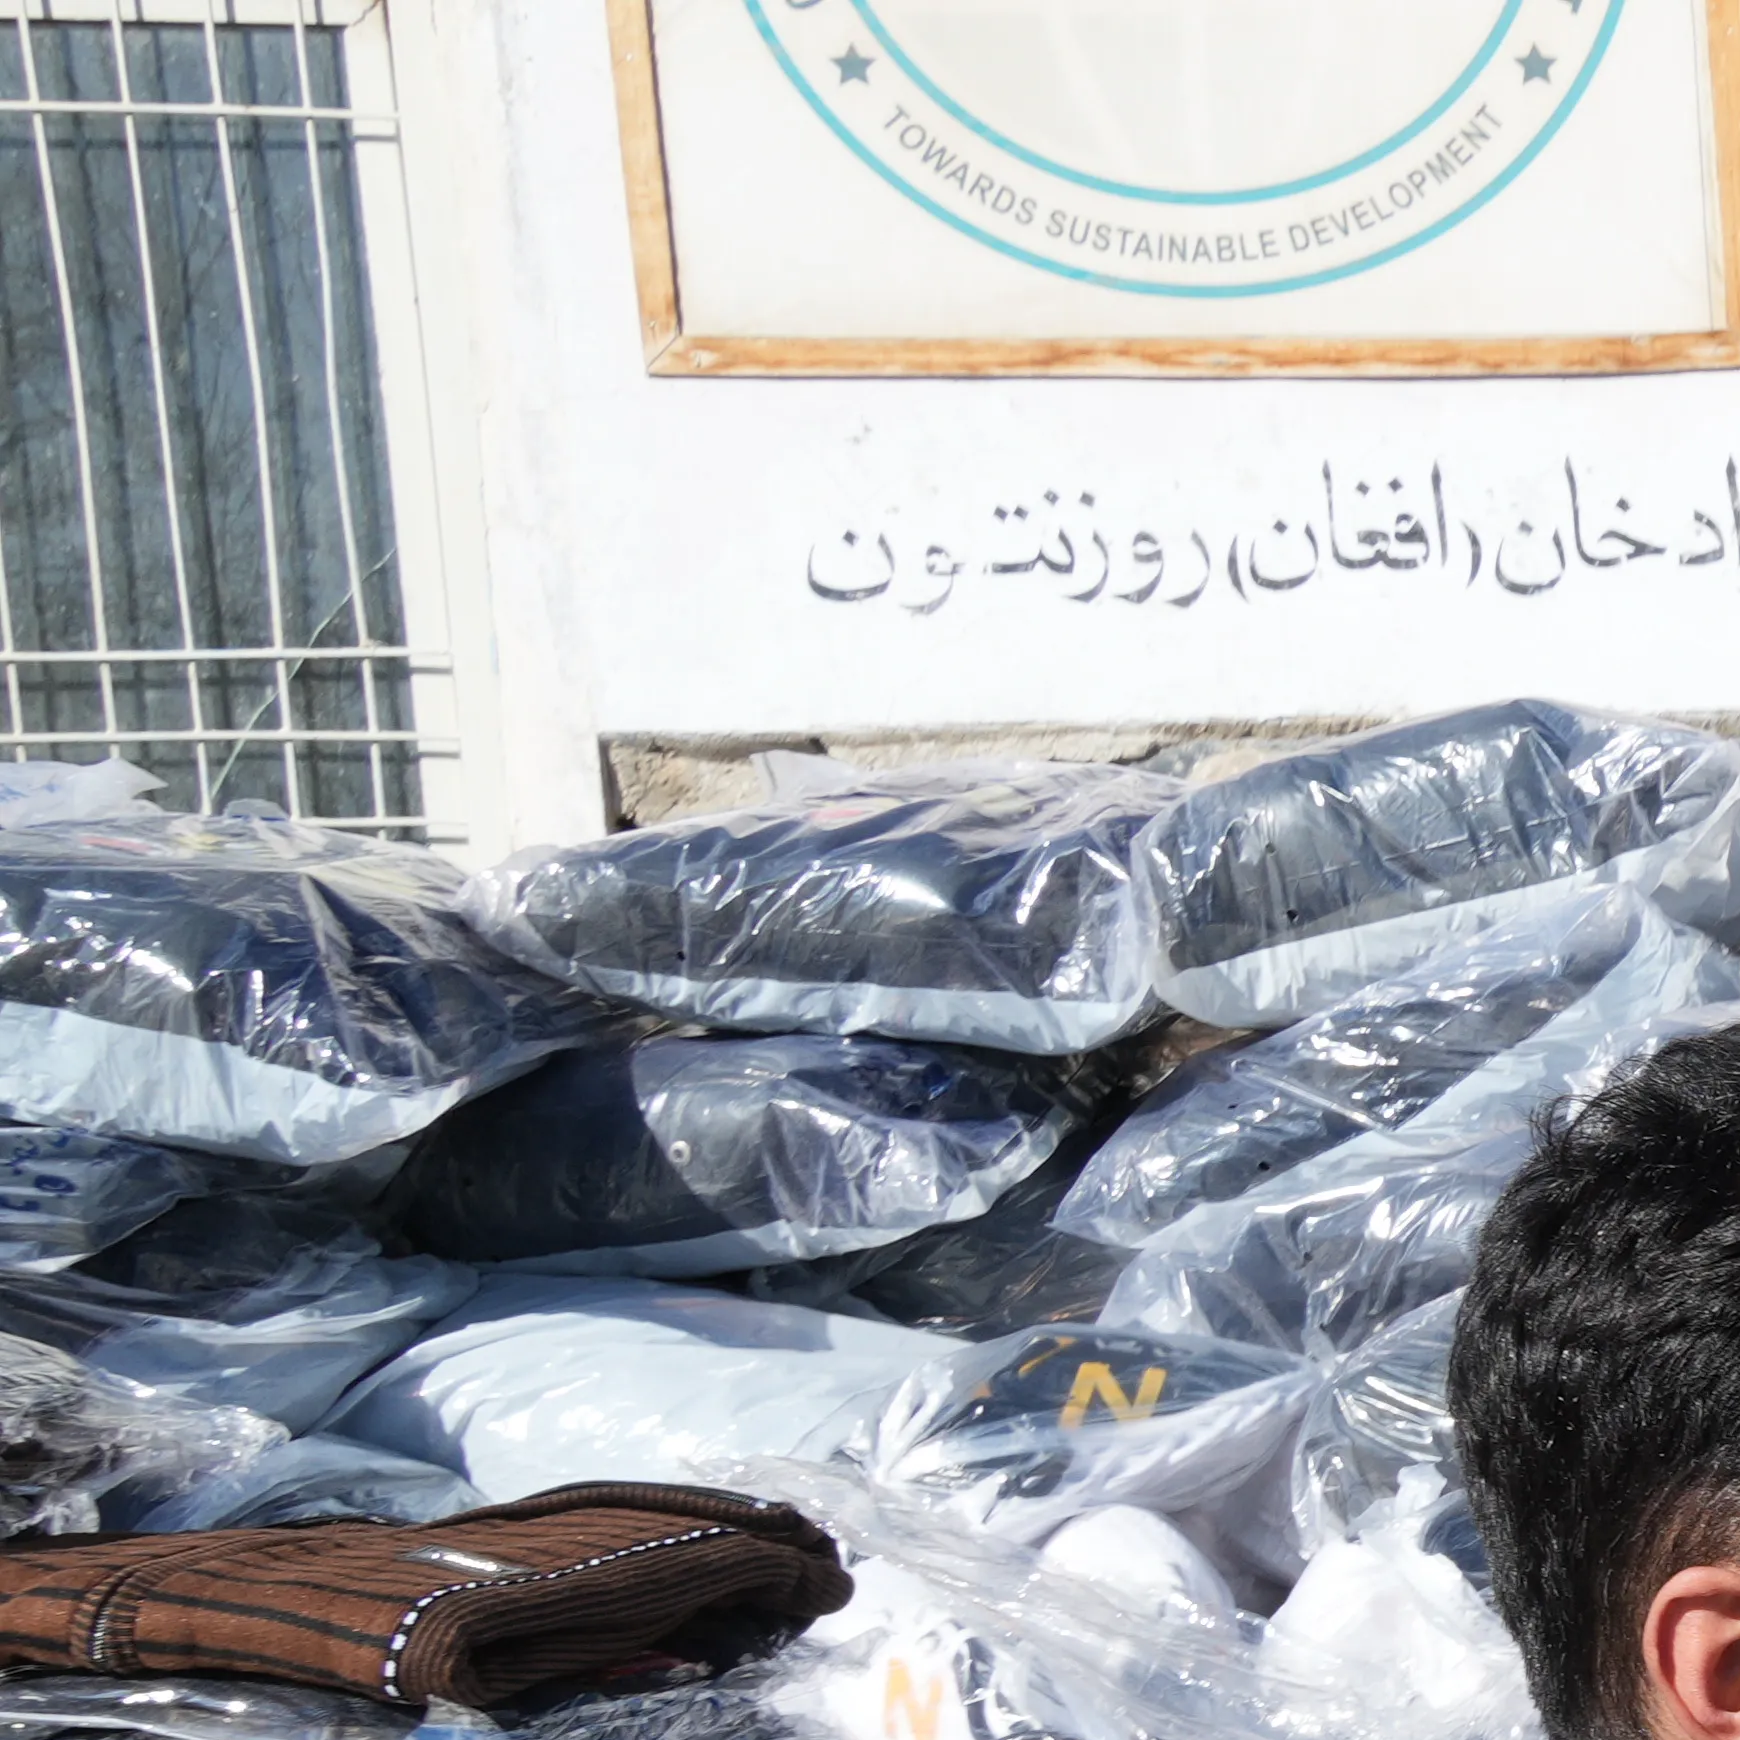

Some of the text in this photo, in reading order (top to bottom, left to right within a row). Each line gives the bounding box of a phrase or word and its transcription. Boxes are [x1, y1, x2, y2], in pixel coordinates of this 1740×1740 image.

[880, 103, 1503, 263] TOWARDS SUSTAINABLE DEVELOPMENT
